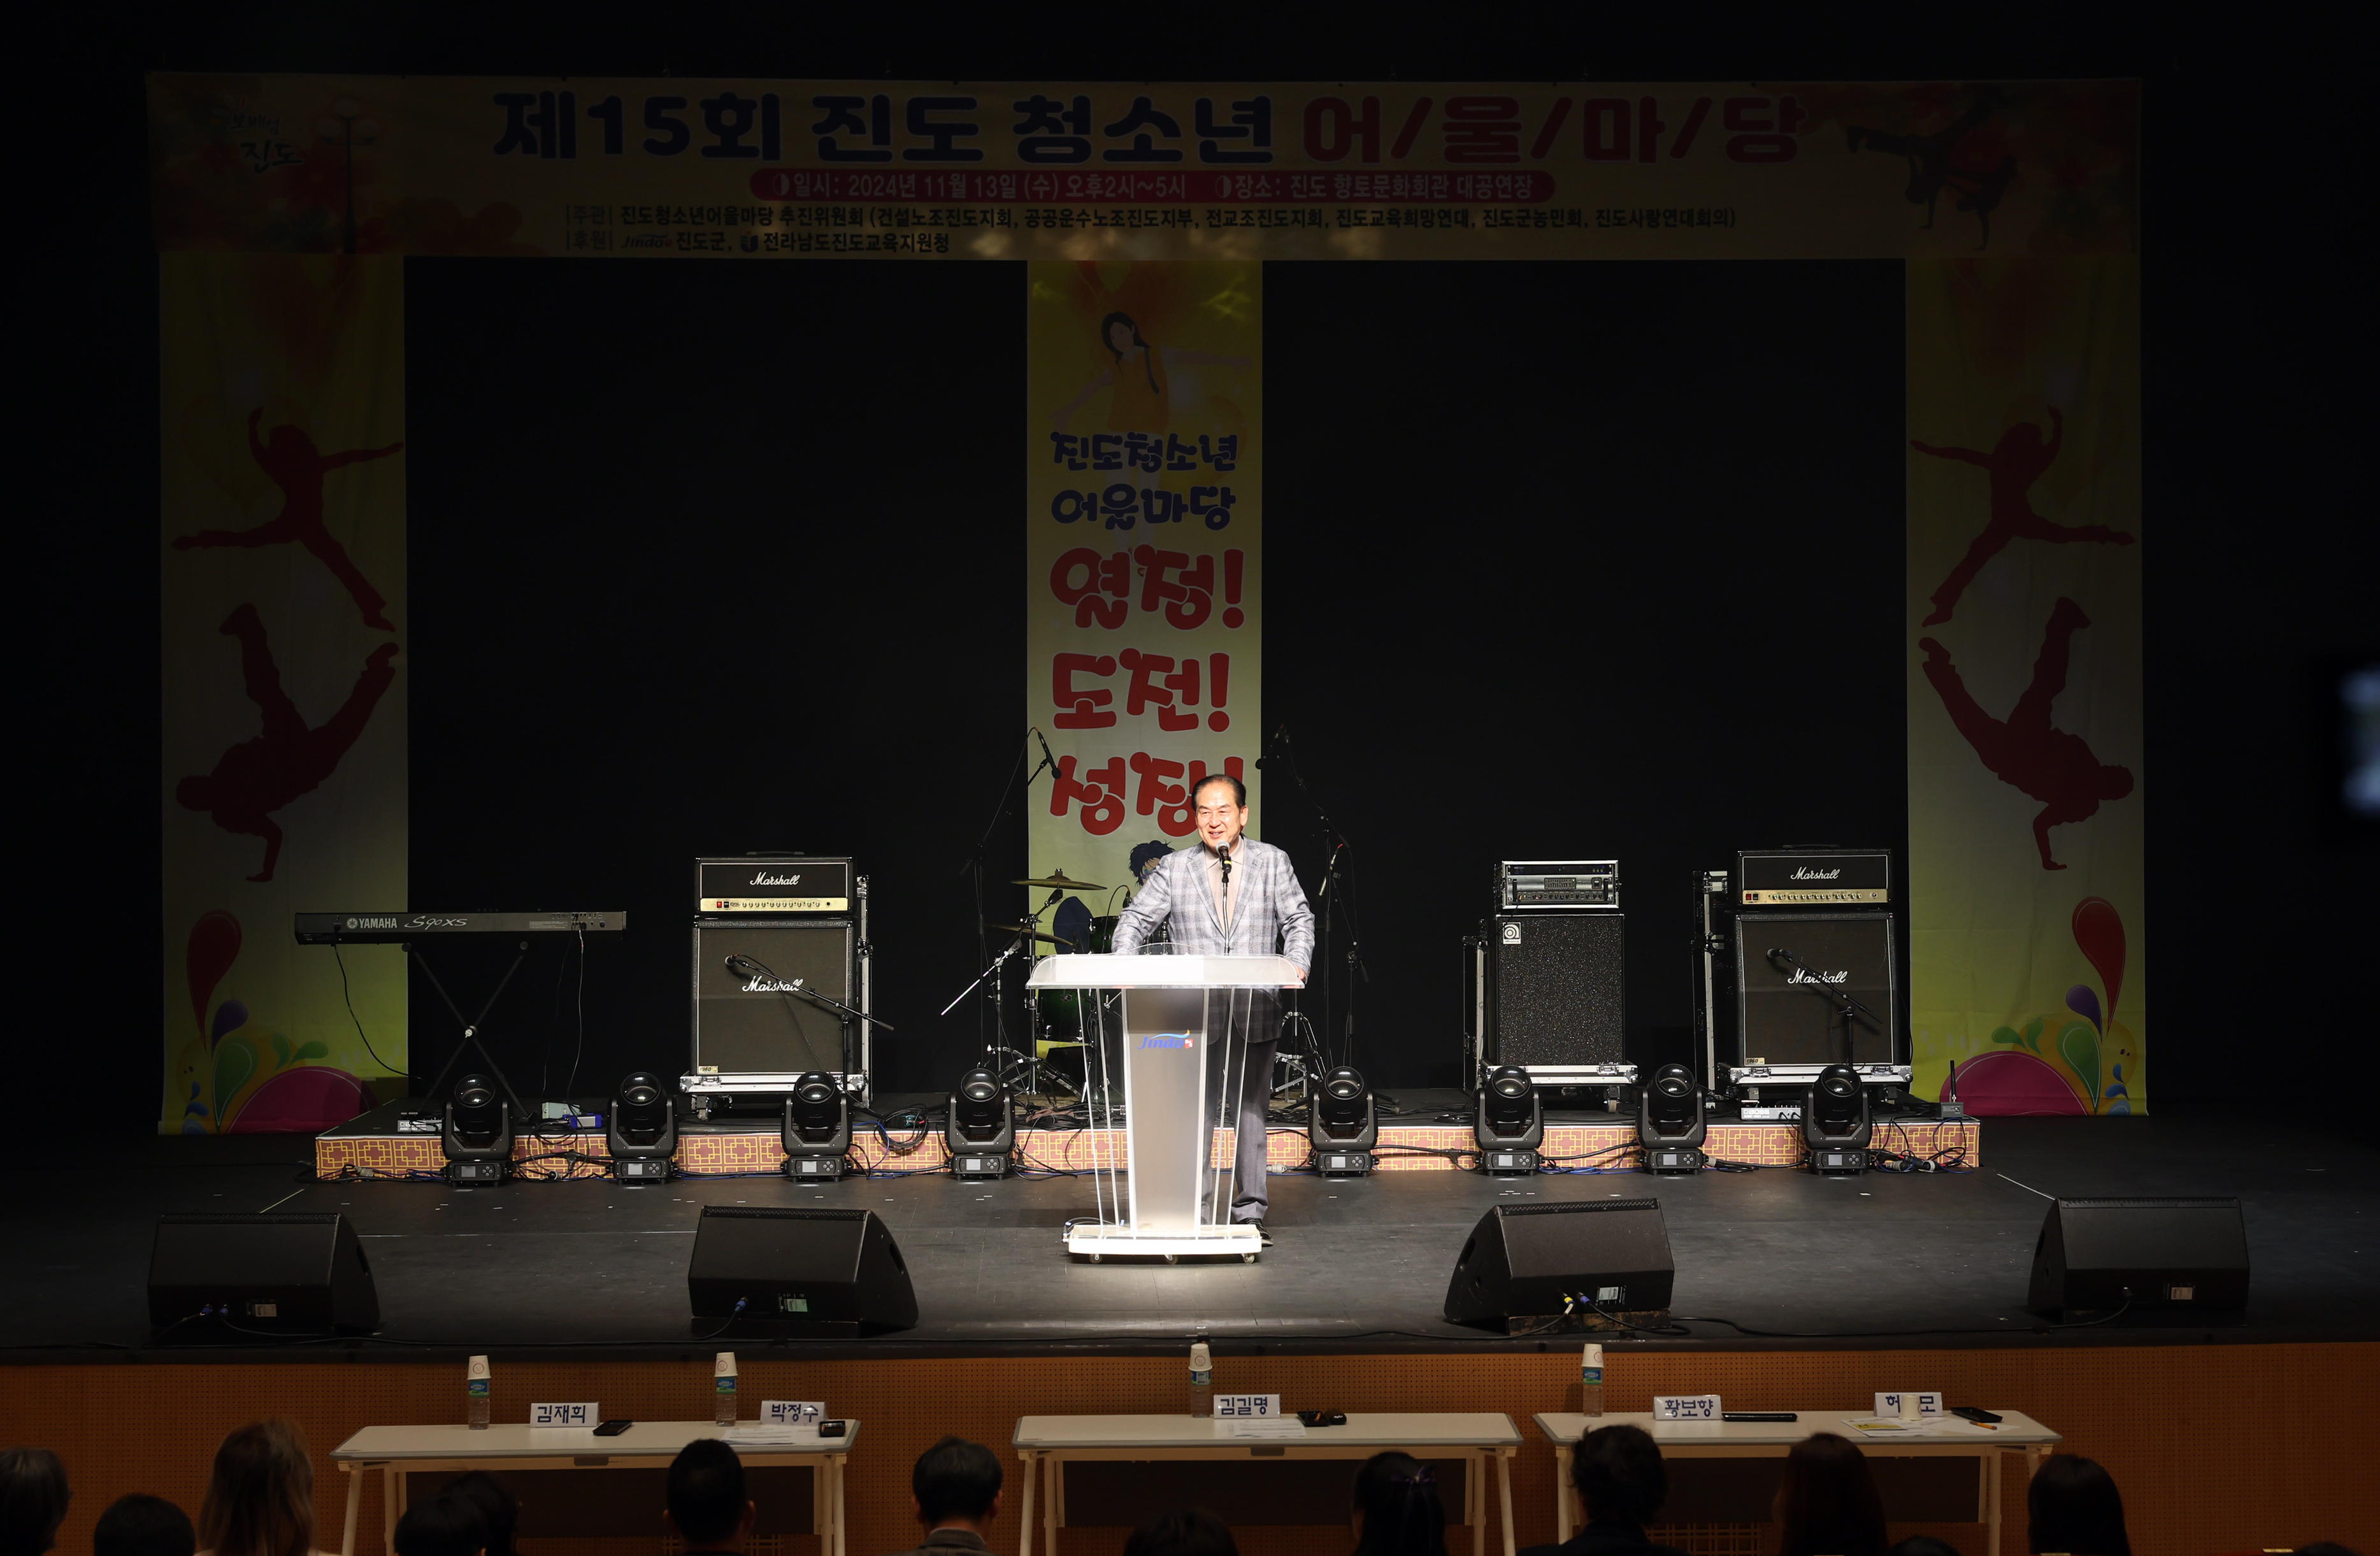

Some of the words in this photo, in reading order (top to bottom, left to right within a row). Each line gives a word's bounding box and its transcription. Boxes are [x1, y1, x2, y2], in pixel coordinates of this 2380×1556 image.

[493, 90, 780, 161] 제15회
[812, 94, 984, 162] 진도
[1012, 94, 1273, 163] 청소년
[1303, 95, 1807, 164] 어/울/마/당
[240, 139, 303, 174] 진도
[794, 172, 839, 198] 일시:
[849, 174, 915, 198] 2024년
[925, 173, 966, 199] 11월
[975, 174, 1016, 199] 13일
[1024, 173, 1059, 201] (수)
[1066, 174, 1186, 199] 오후2시~5시
[1236, 175, 1281, 199] 장소:
[1291, 175, 1327, 199] 진도
[1333, 174, 1449, 199] 향토문화회관
[1456, 174, 1533, 199] 대공연장
[621, 206, 773, 227] 진도청소년어울마당
[780, 206, 864, 227] 추진위원회
[676, 231, 733, 252] 진도군,
[763, 232, 949, 253] 전라남도진도교육지원청
[1050, 431, 1237, 473] 진도청소년
[1051, 483, 1237, 530] 어울마당
[1050, 544, 1244, 630] 열정!
[1052, 648, 1229, 732] 도전!
[750, 871, 801, 885] Marshall
[1790, 866, 1840, 880] Marshall
[359, 918, 398, 929] YAMAHA
[742, 976, 803, 992] Marshall
[1138, 1036, 1184, 1049] Jindo
[538, 1405, 585, 1424] 김재희
[771, 1404, 819, 1422] 박정수
[1221, 1397, 1268, 1415] 김길명
[1665, 1399, 1714, 1417] 황보향
